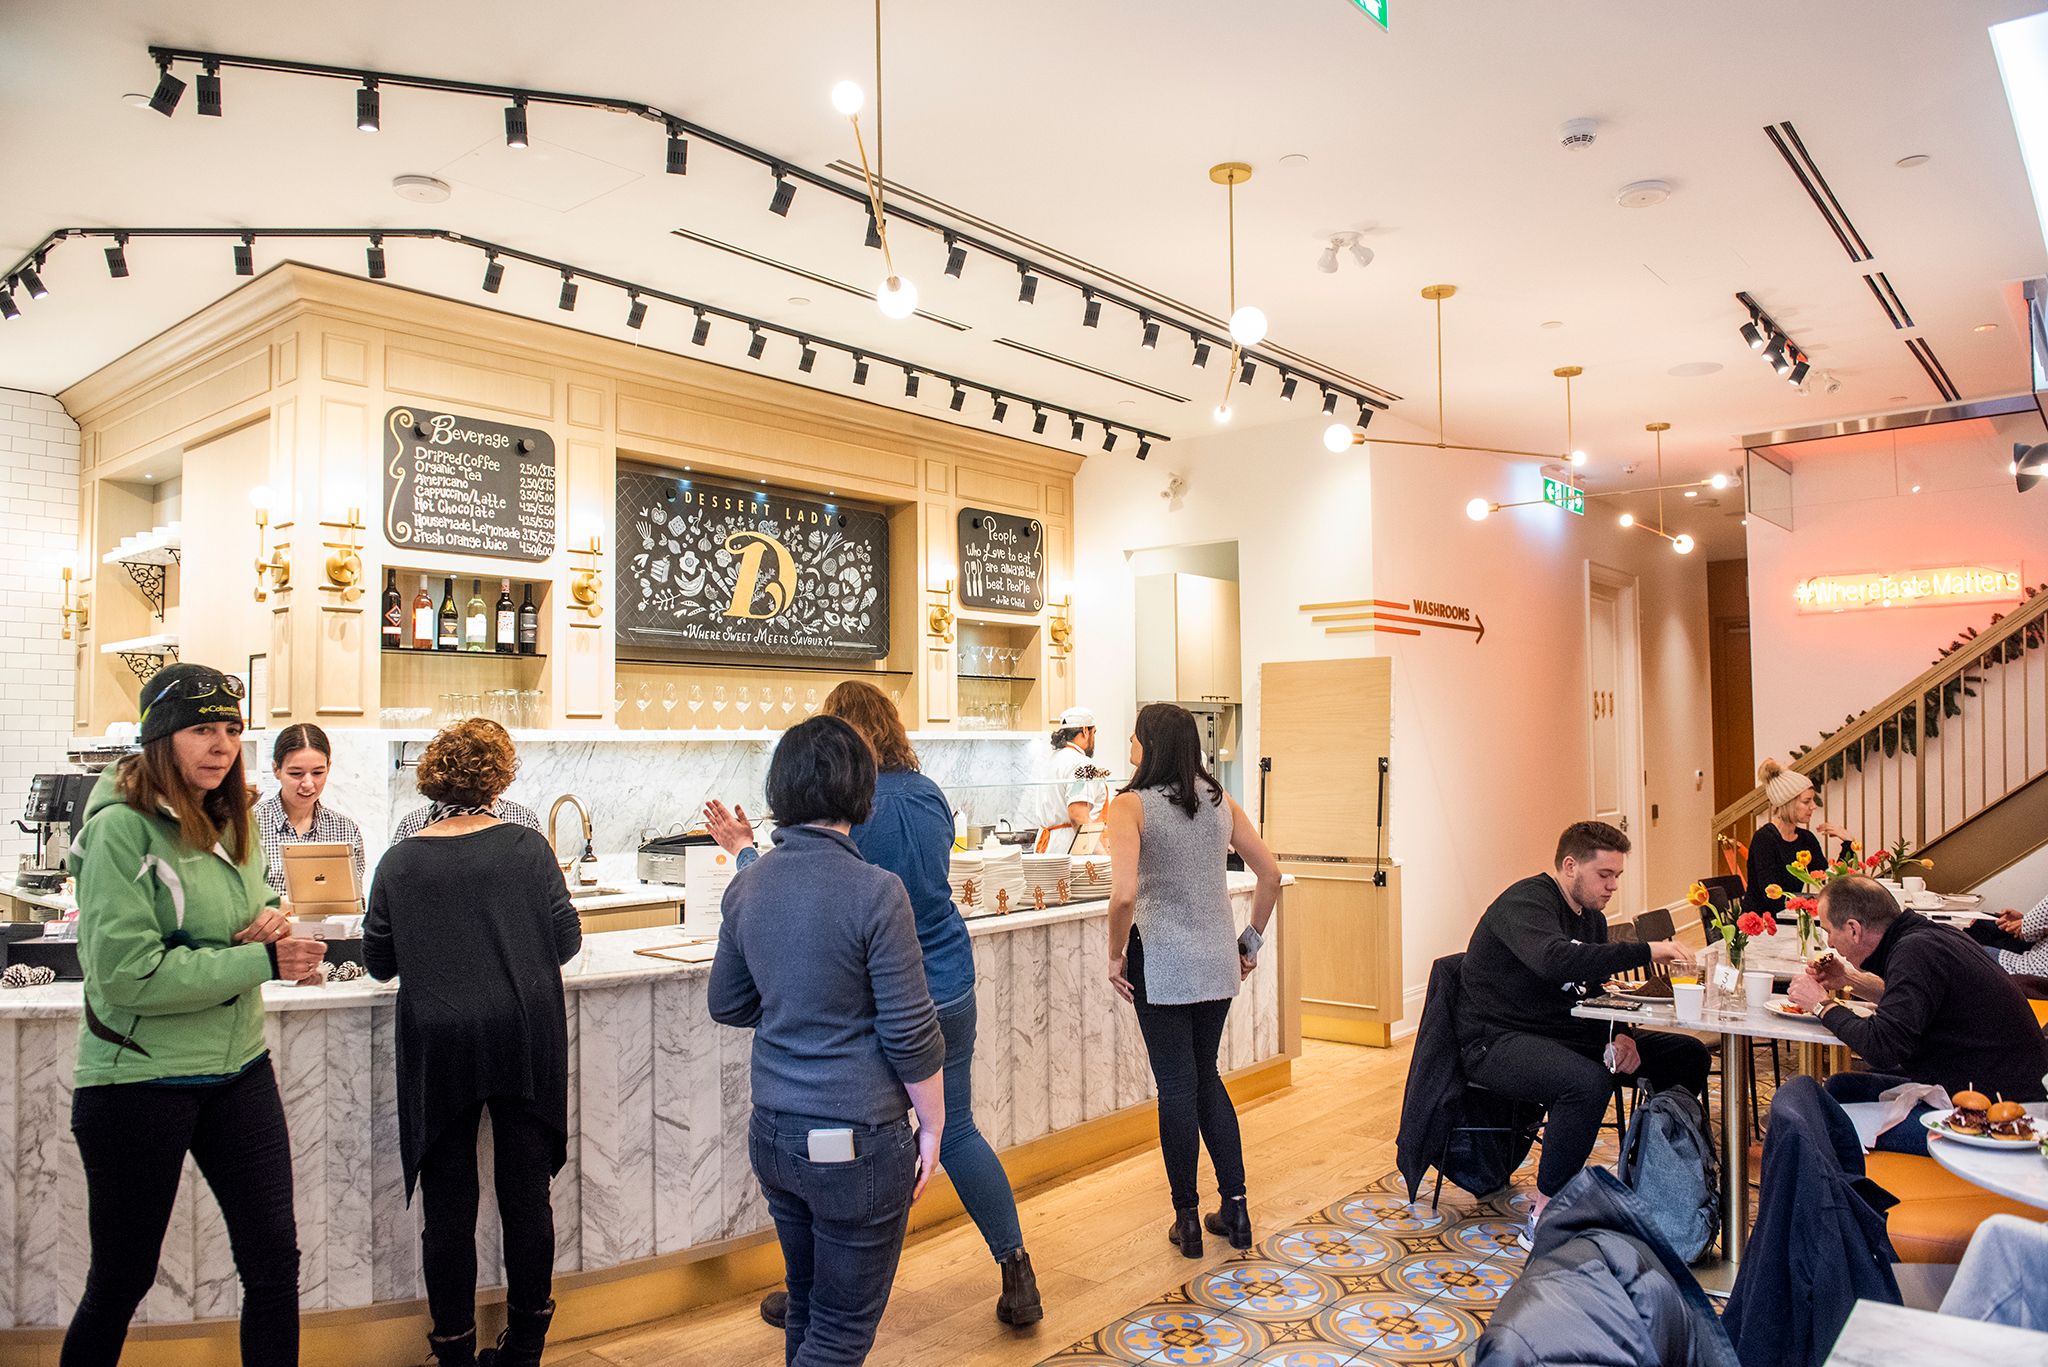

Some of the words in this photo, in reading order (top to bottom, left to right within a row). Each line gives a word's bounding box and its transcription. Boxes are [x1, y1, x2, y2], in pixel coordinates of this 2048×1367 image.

[430, 415, 510, 448] Beverage
[414, 446, 463, 465] Dripped
[463, 453, 501, 472] Coffee
[414, 460, 456, 476] Organic
[459, 466, 482, 481] Tea
[414, 473, 468, 488] Americano
[413, 494, 435, 513] Hot
[437, 499, 496, 519] Chocolate
[684, 491, 770, 516] DESSERT
[785, 507, 832, 527] LADY
[412, 512, 472, 531] Housemade
[472, 519, 521, 540] Lemonade
[983, 516, 1017, 545] People
[413, 529, 446, 545] Fresh
[482, 536, 509, 551] Juice
[965, 542, 982, 557] who
[982, 542, 1006, 562] Love
[1007, 547, 1017, 562] to
[1017, 551, 1032, 565] eat
[985, 562, 999, 573] are
[1000, 563, 1025, 577] always
[1024, 565, 1036, 579] the
[985, 575, 1004, 591] best
[1793, 571, 2021, 604] #WhereTasteMatters
[1413, 599, 1470, 621] WASHROOMS
